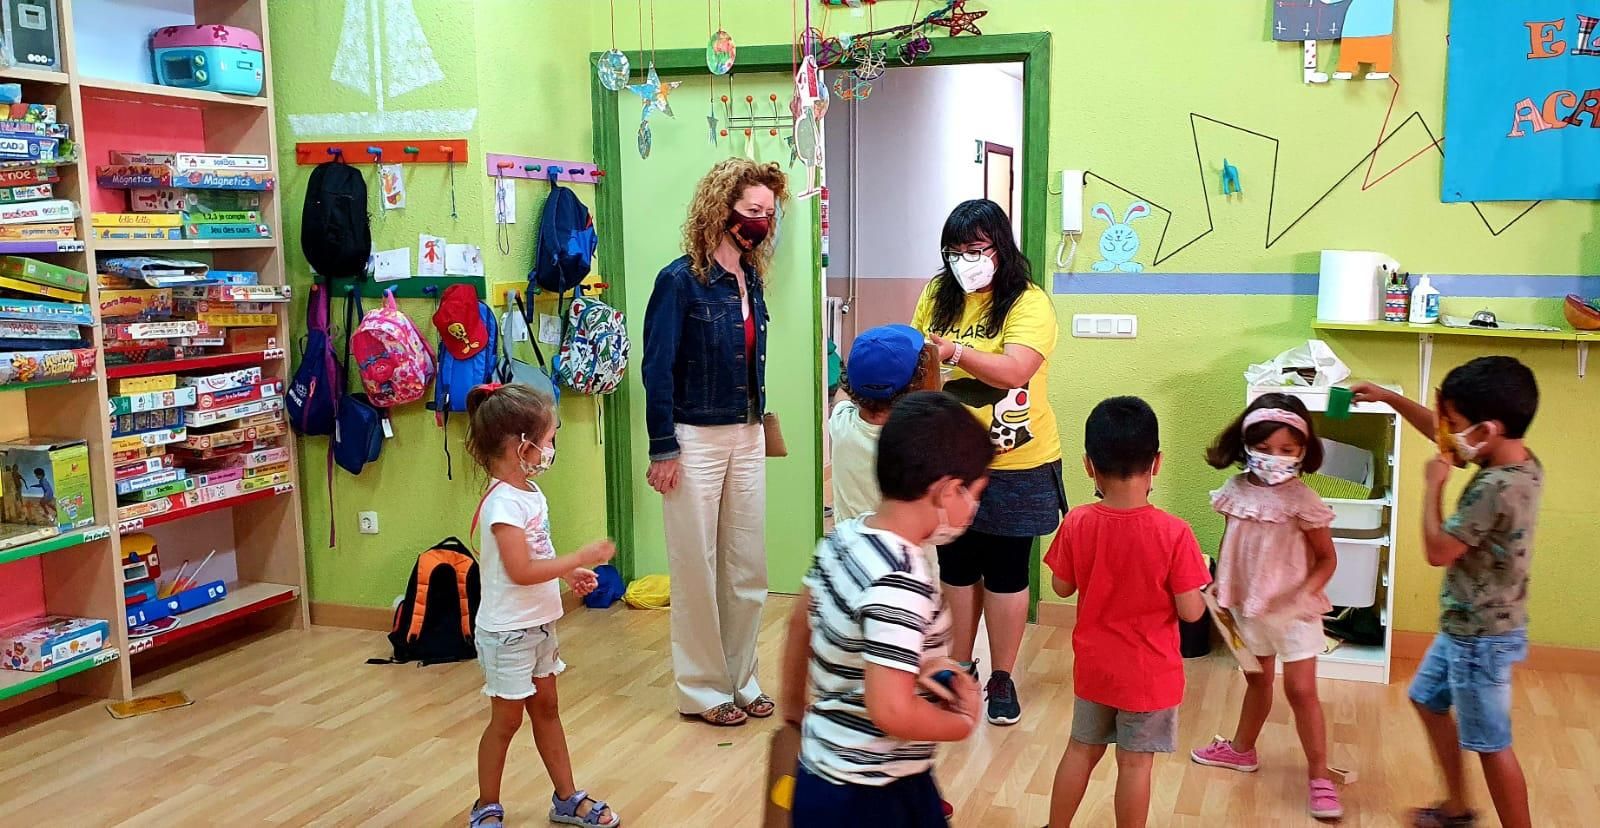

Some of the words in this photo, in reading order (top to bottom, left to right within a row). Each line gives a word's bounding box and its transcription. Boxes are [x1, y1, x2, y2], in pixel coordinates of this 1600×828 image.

[112, 174, 153, 186] Magnetics
[203, 174, 251, 189] Magnetics
[928, 321, 1000, 340] AMARU
